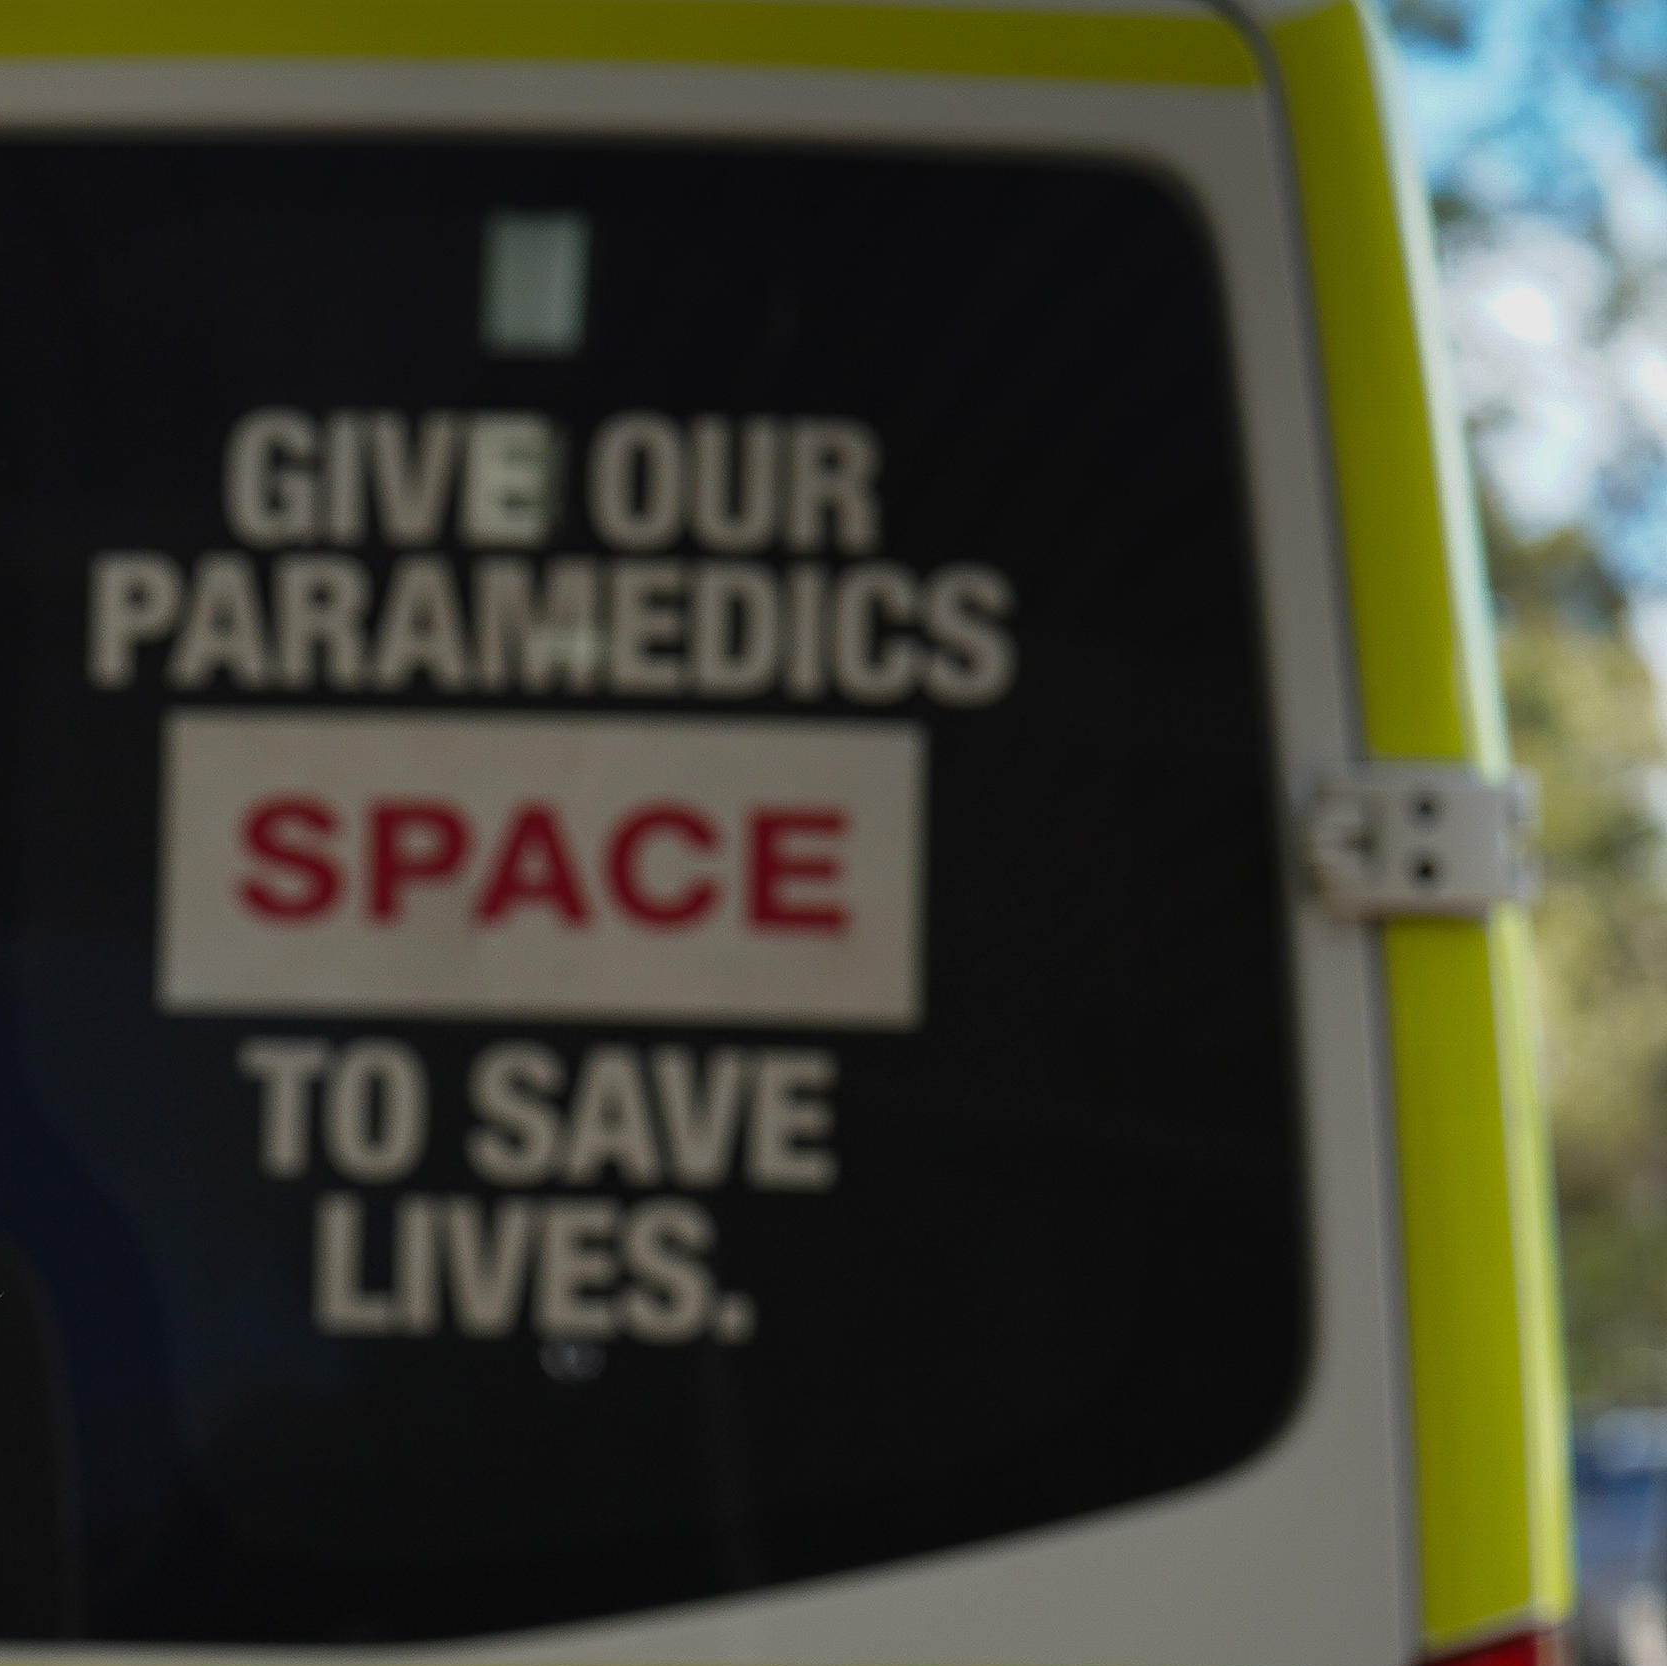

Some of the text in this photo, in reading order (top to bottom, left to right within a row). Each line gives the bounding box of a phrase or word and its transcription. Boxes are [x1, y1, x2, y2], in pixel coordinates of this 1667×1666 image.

[223, 410, 880, 554] GIVE OUR
[86, 551, 1017, 706] PARAMEDICS
[235, 796, 850, 936] SPACE
[240, 1038, 837, 1190] TO SAVE
[313, 1196, 756, 1345] LIVES.
